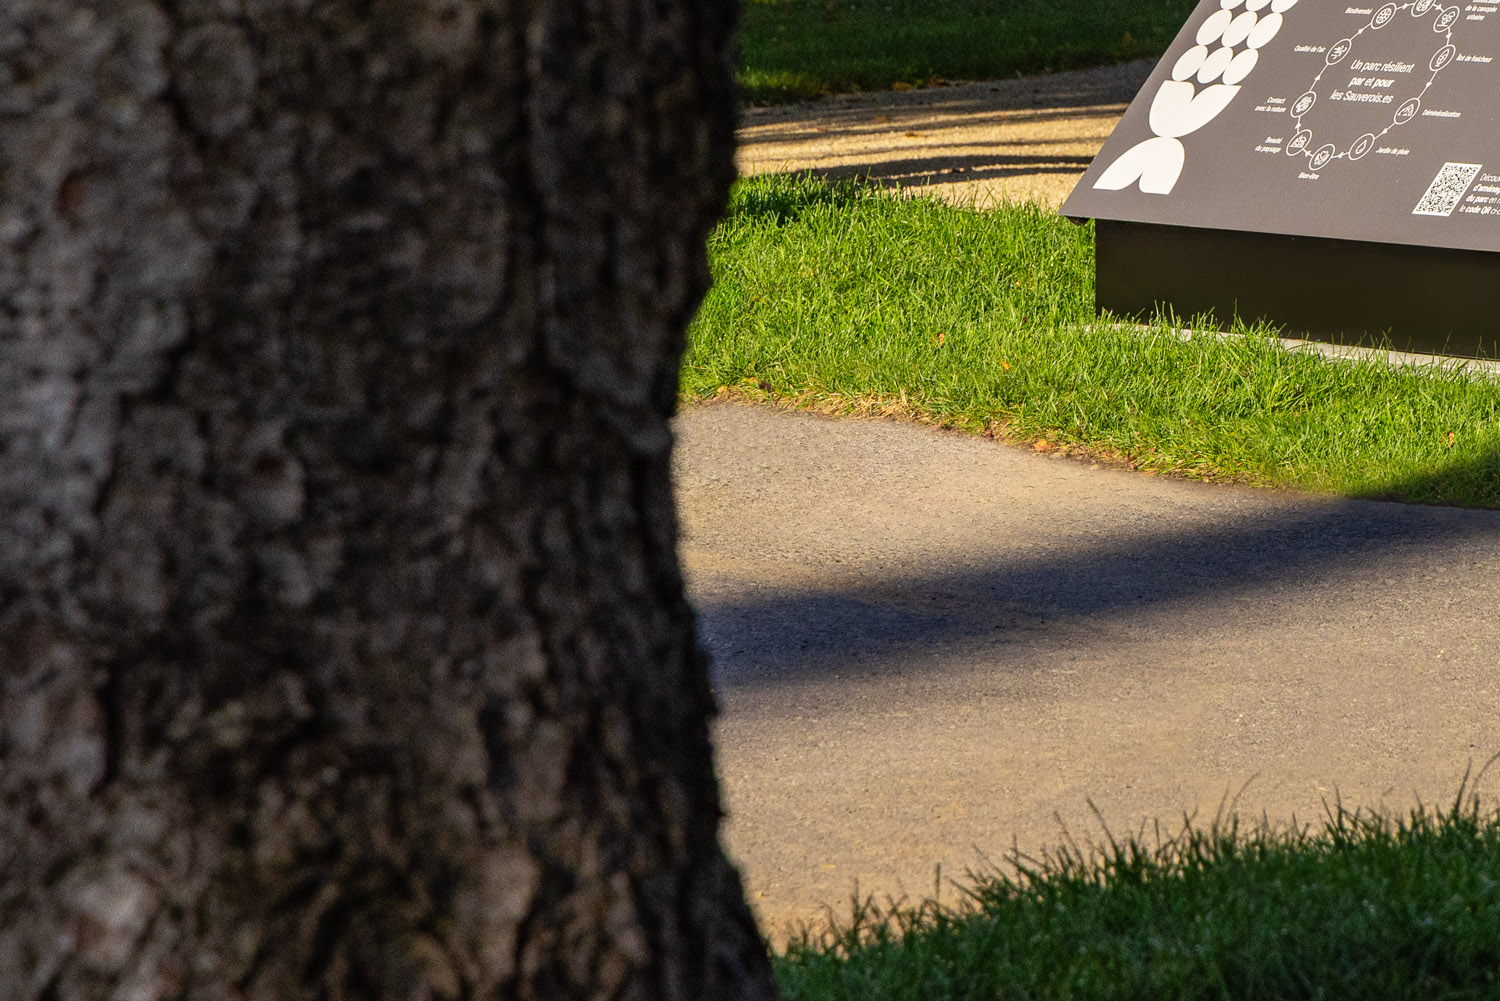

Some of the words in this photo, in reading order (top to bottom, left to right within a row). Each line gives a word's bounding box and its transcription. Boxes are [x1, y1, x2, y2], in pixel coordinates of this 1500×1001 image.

[1350, 59, 1364, 70] Un
[1360, 62, 1382, 72] parc
[1380, 61, 1415, 73] résilient
[1347, 77, 1366, 88] par
[1364, 77, 1375, 86] et
[1371, 79, 1395, 89] pour
[1329, 89, 1344, 100] les
[1343, 90, 1394, 104] Sauverois.es
